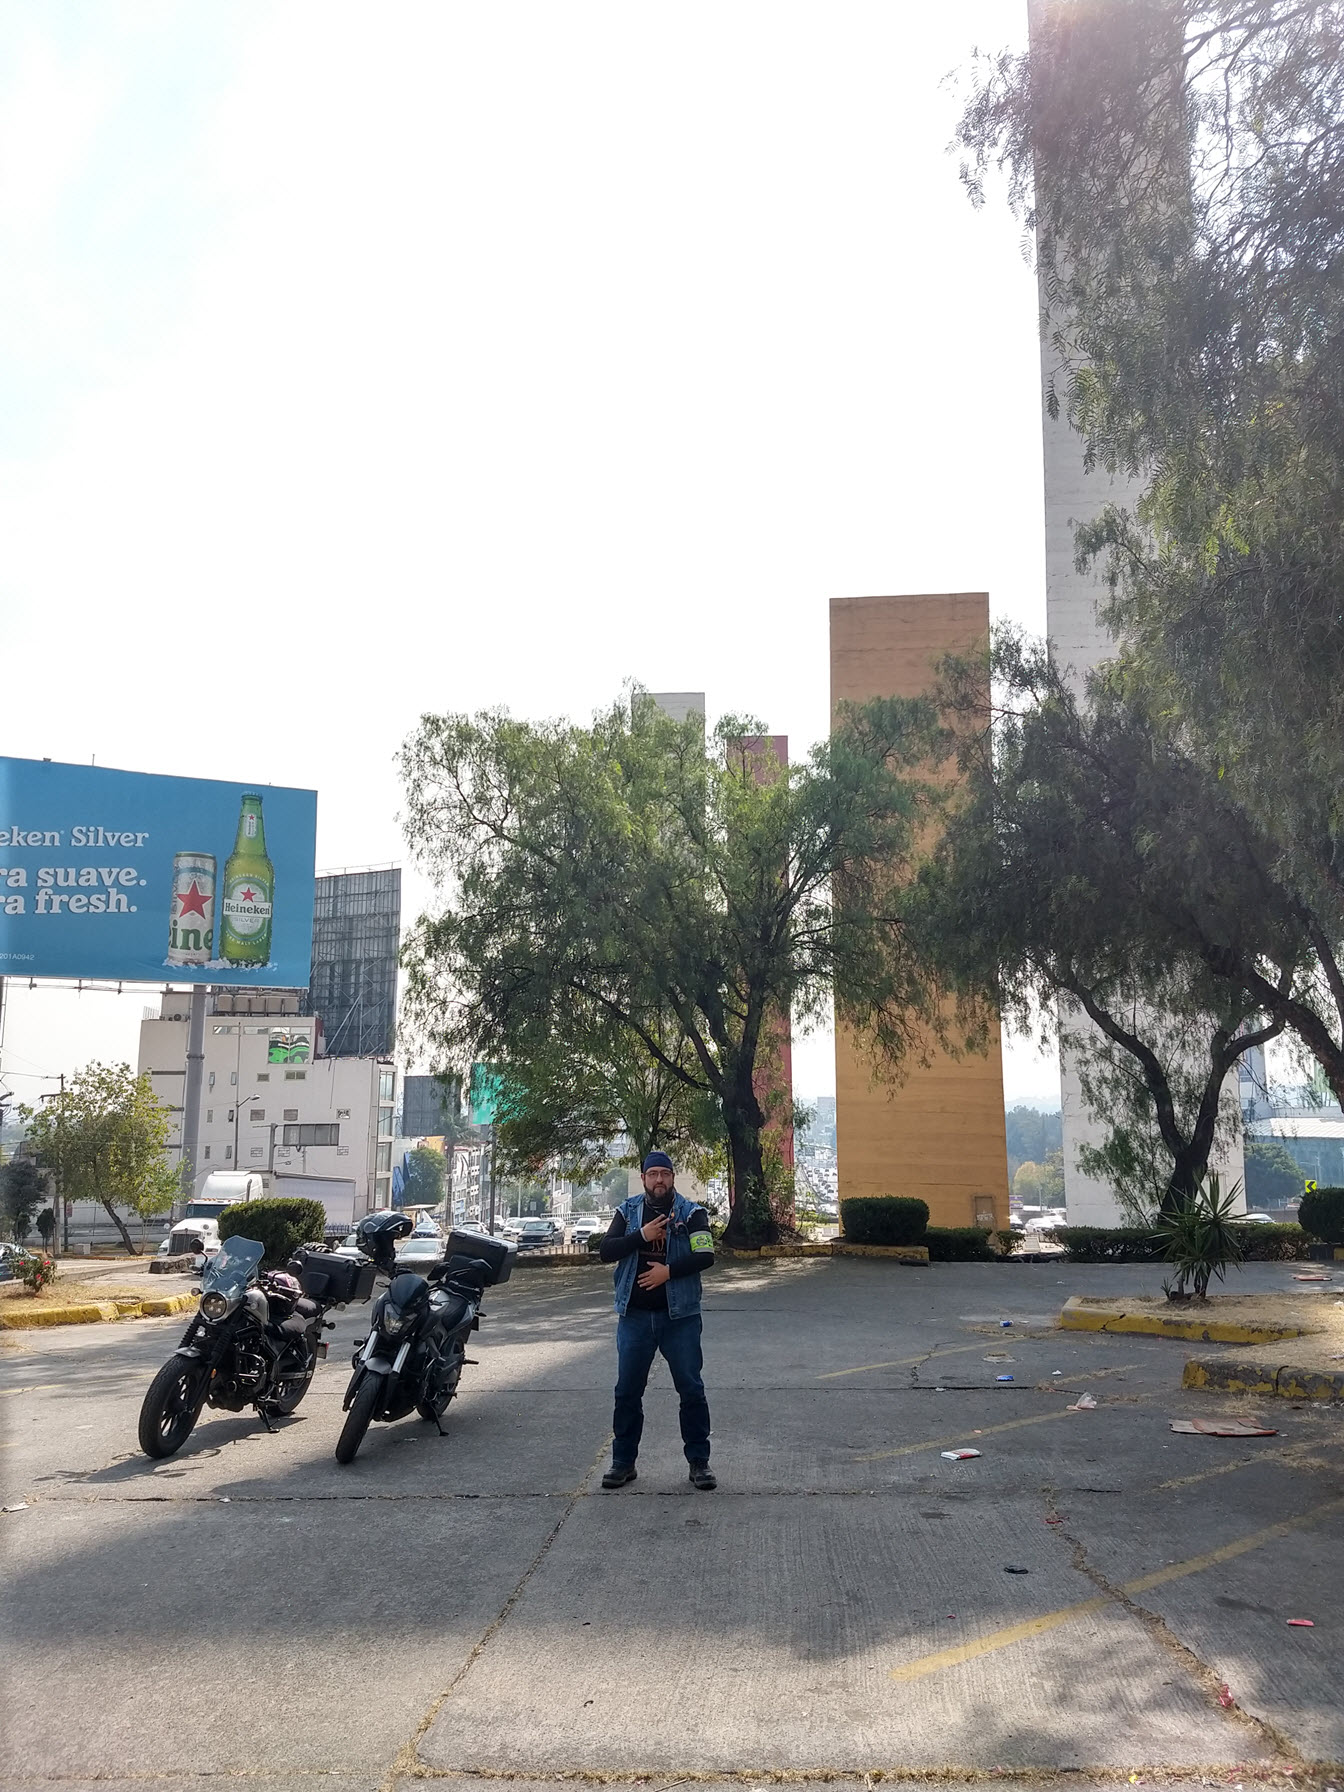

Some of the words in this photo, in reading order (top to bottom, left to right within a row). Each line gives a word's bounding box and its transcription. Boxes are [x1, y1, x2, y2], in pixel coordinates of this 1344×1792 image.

[71, 826, 149, 847] Silver
[37, 867, 147, 887] suave.
[34, 887, 138, 914] fresh.
[224, 902, 270, 915] Heineken
